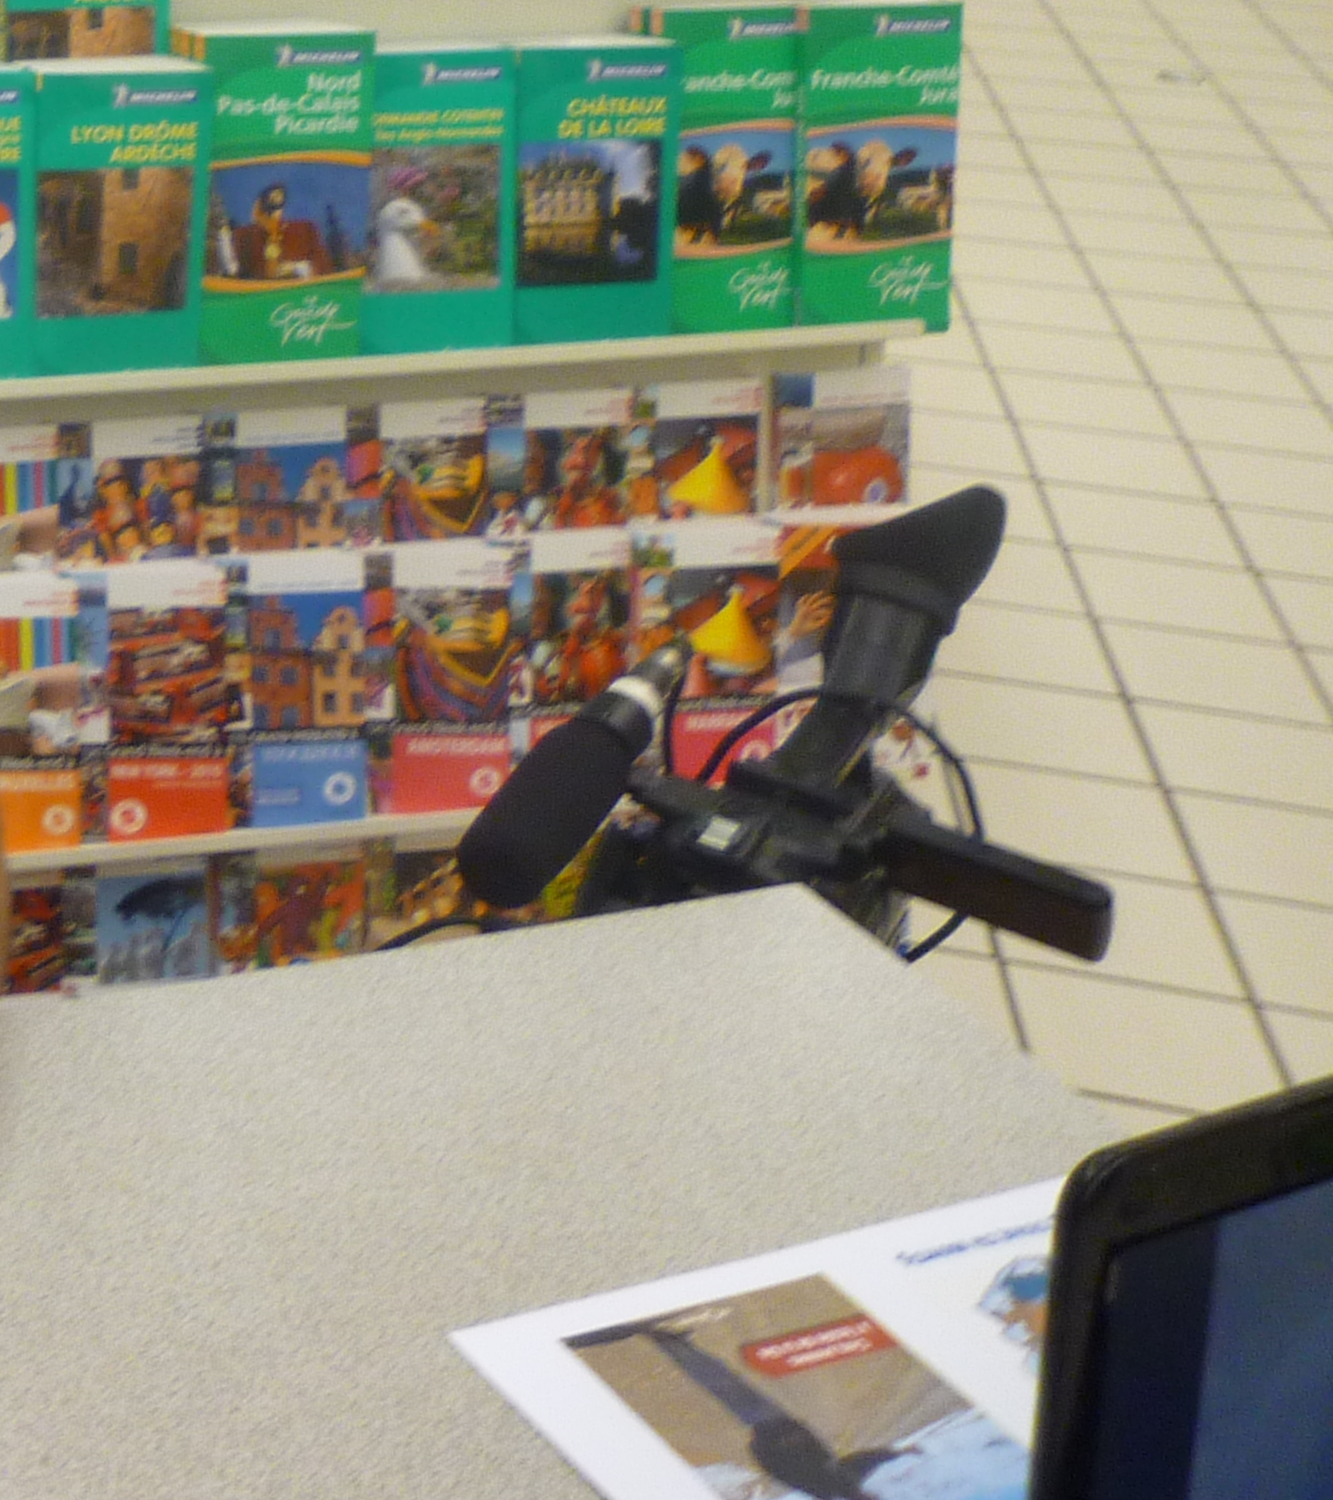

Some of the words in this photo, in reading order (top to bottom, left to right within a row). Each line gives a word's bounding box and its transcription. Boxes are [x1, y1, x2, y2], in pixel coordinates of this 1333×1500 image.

[307, 71, 361, 94] Nord
[129, 88, 198, 103] MICHELIN
[217, 94, 361, 115] Pas-de-Calais
[71, 124, 123, 145] LYON
[275, 113, 359, 135] Picardie
